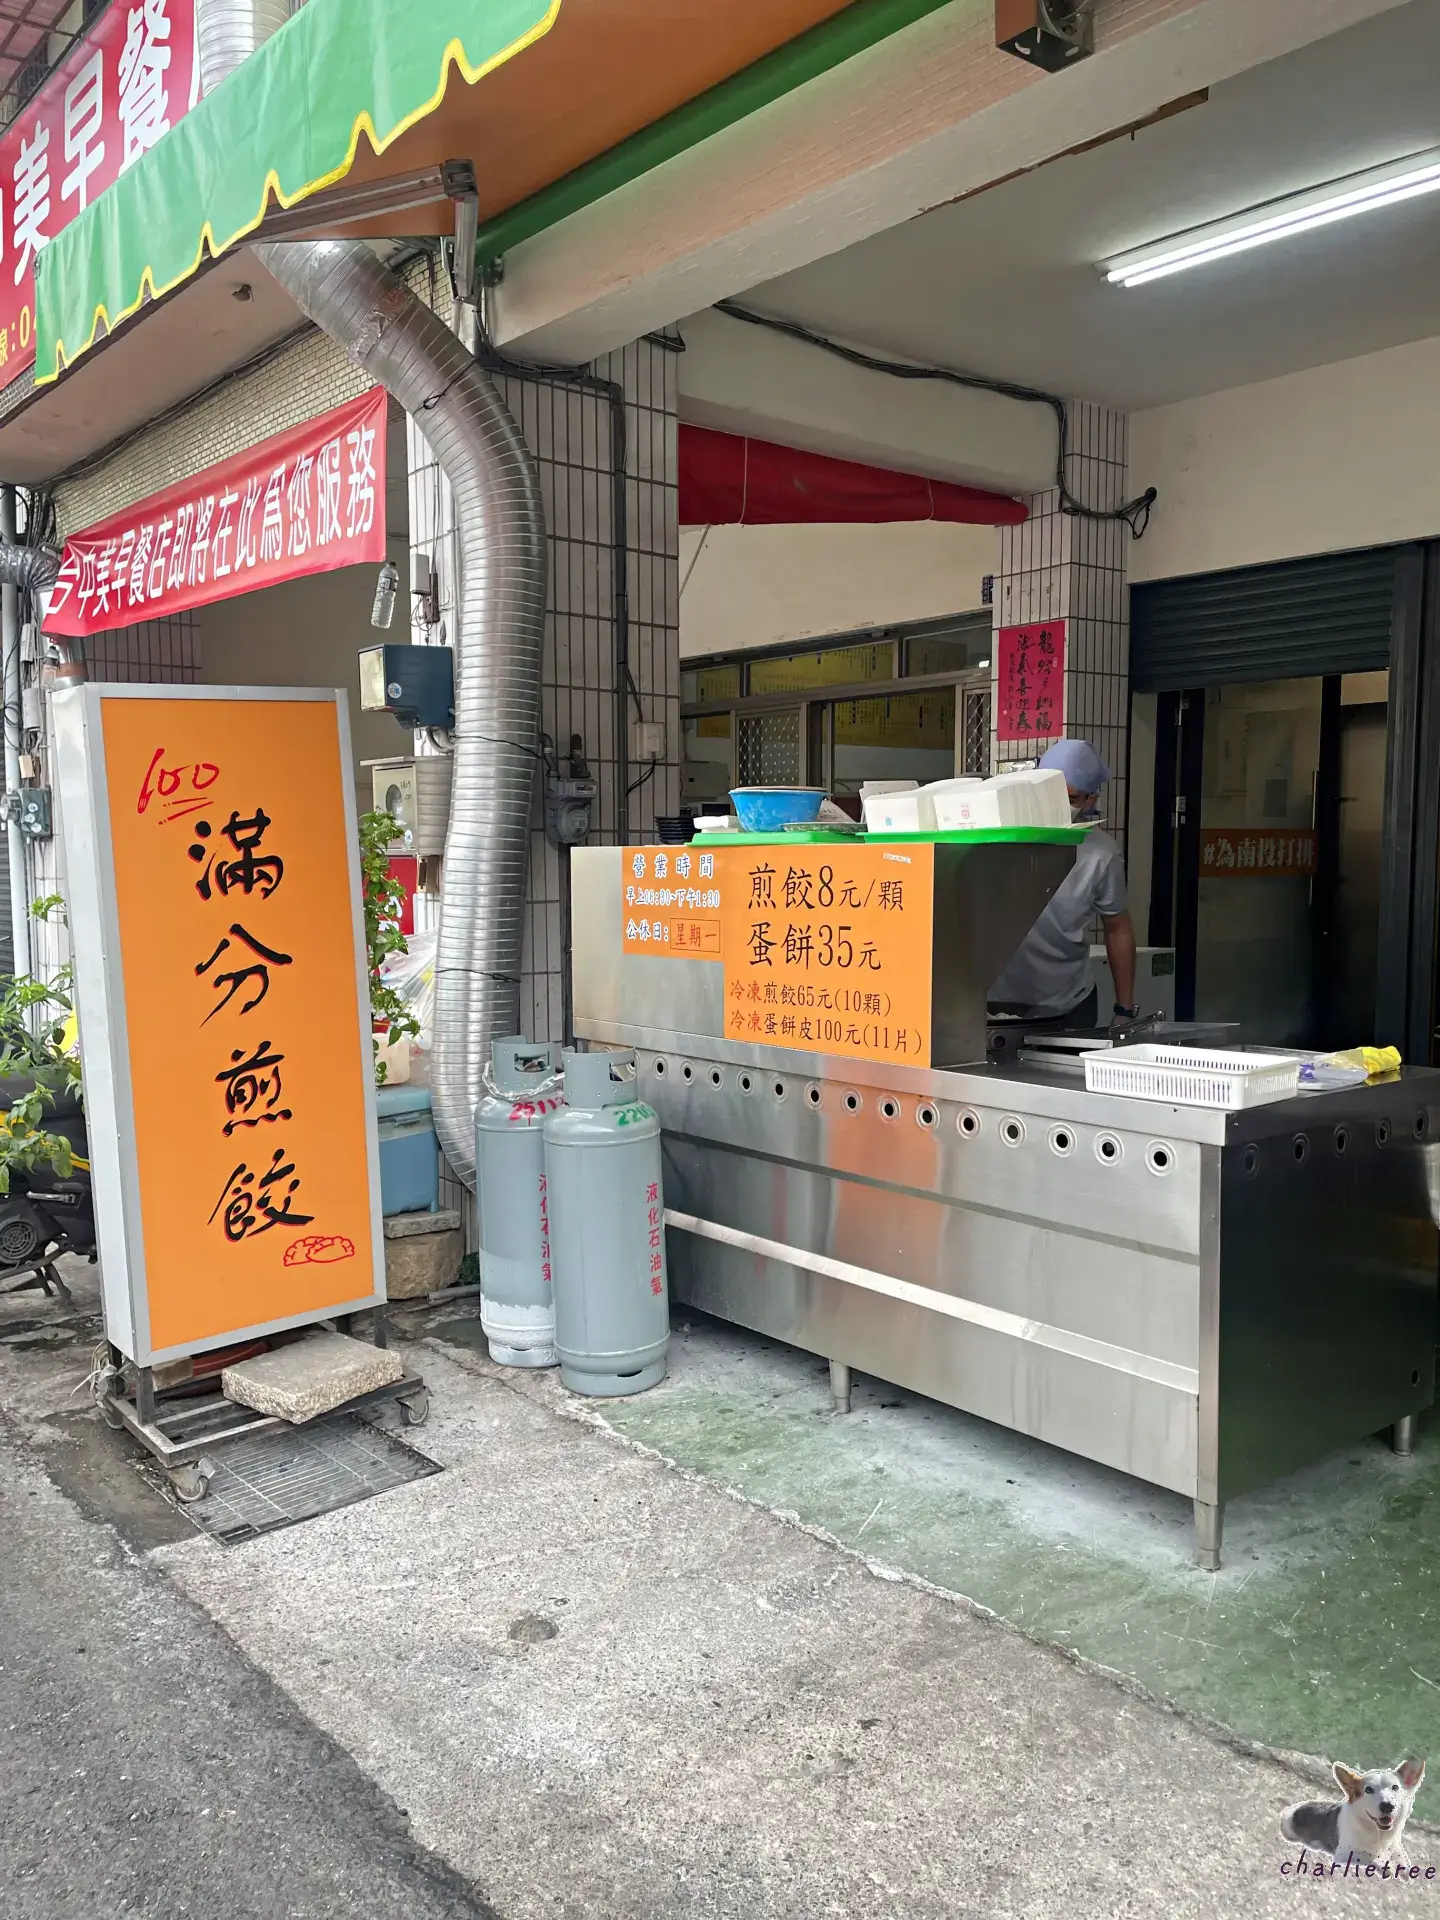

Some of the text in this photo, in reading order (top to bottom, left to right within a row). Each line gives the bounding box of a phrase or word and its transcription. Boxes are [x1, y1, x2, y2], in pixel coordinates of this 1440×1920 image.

[0, 0, 171, 286] 美早餐
[137, 748, 220, 814] 100
[633, 853, 714, 879] 營業時間
[747, 865, 905, 912] 煎餃8元/顆
[675, 922, 717, 948] 星期一
[746, 921, 882, 971] 蛋餅35元
[730, 979, 892, 1018] 冷凍煎餃65元(10顆)
[188, 808, 314, 1242] 滿分煎餃
[730, 1010, 923, 1056] 冷凍蛋餅皮100元(11片)
[646, 1181, 663, 1297] 液化石油氣
